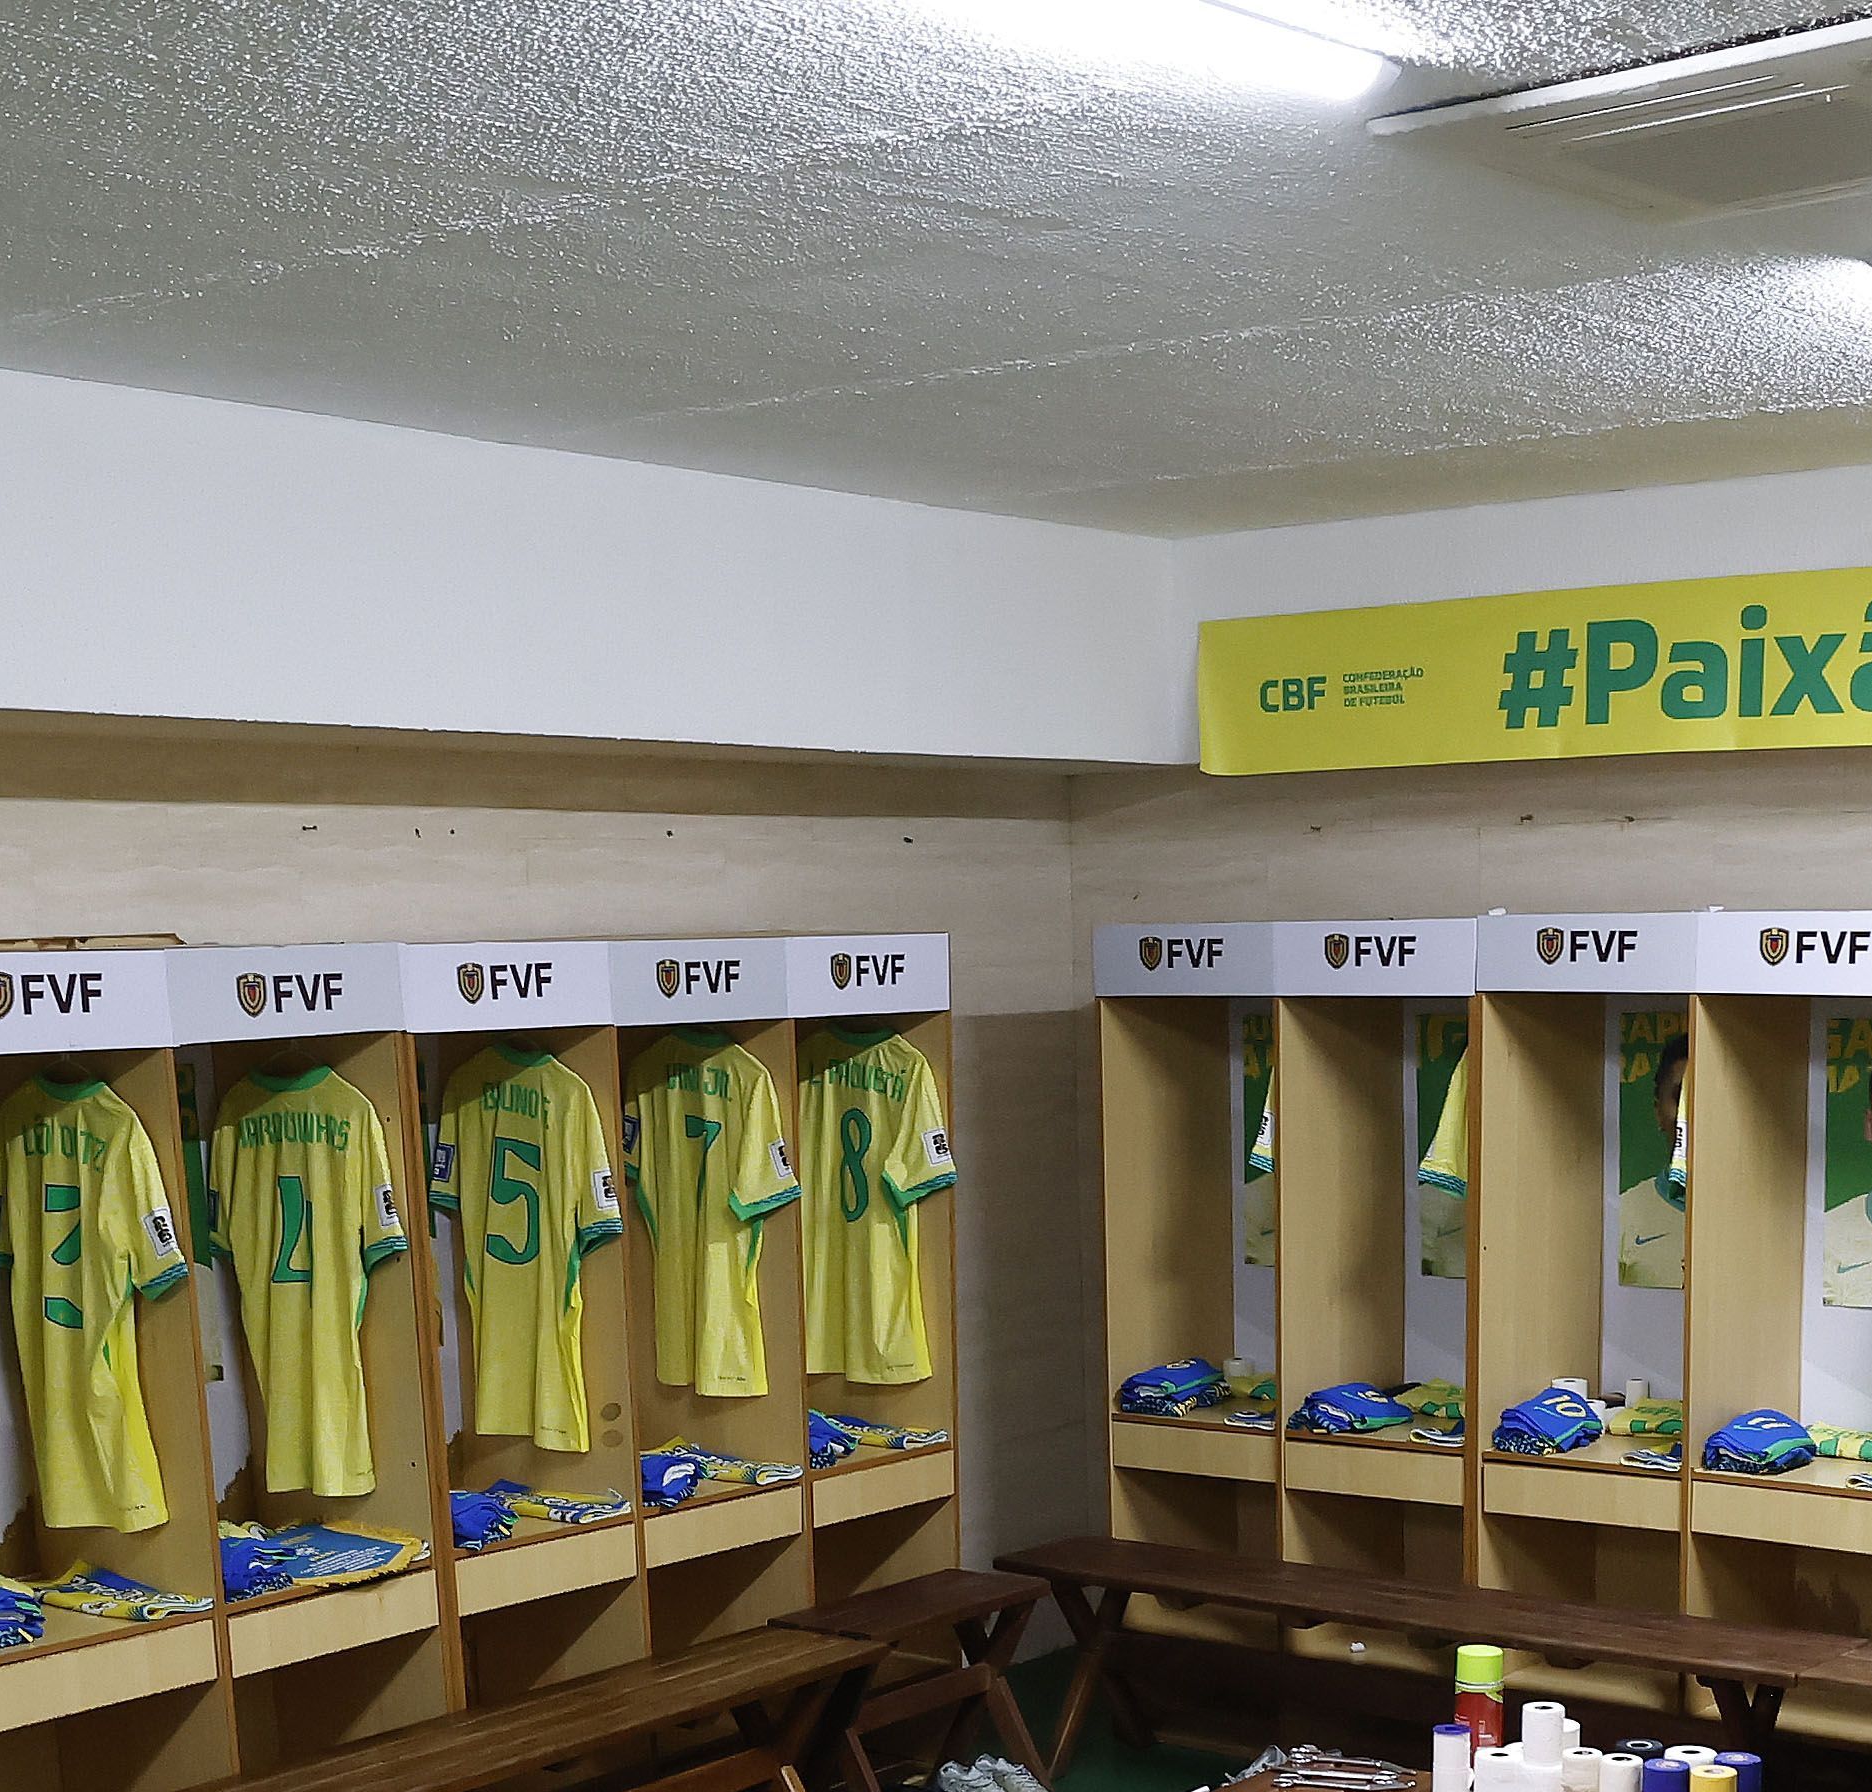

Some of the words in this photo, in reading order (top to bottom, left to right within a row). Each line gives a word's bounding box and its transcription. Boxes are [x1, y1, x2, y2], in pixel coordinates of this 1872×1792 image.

[1342, 666, 1424, 684] CONFEDERAÇÃO
[1343, 683, 1403, 696] BRASILEIRA
[1259, 676, 1327, 712] CBF
[1343, 697, 1357, 708] DE
[1359, 695, 1405, 708] FUTEBOL
[1166, 938, 1224, 969] FVF
[1354, 935, 1417, 967] FVF
[1569, 930, 1638, 963] FVF
[1795, 930, 1872, 965] FVF
[489, 962, 553, 1000] FVF
[684, 959, 741, 995] FVF
[855, 953, 905, 987] FVF
[20, 972, 103, 1015] FVF
[272, 972, 343, 1013] FVF
[840, 1107, 872, 1223] 8
[486, 1136, 542, 1266] 5
[1541, 1394, 1588, 1418] 10
